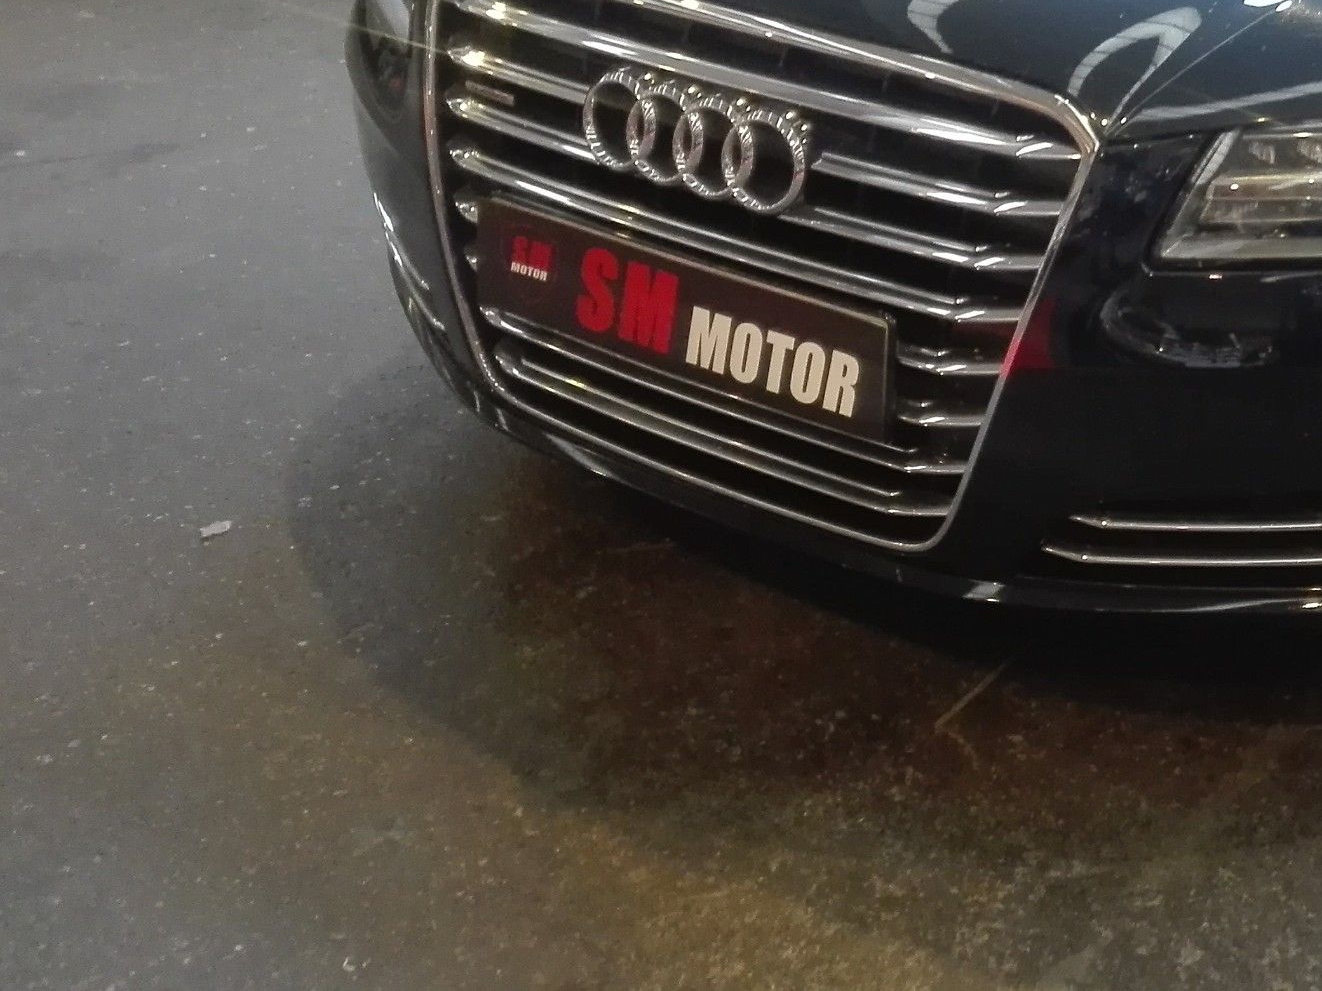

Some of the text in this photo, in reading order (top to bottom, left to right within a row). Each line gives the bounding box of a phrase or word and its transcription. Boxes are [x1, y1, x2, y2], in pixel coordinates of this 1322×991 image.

[513, 236, 554, 270] SM
[510, 261, 548, 282] MOTOR
[575, 247, 860, 418] SM MOTOR
